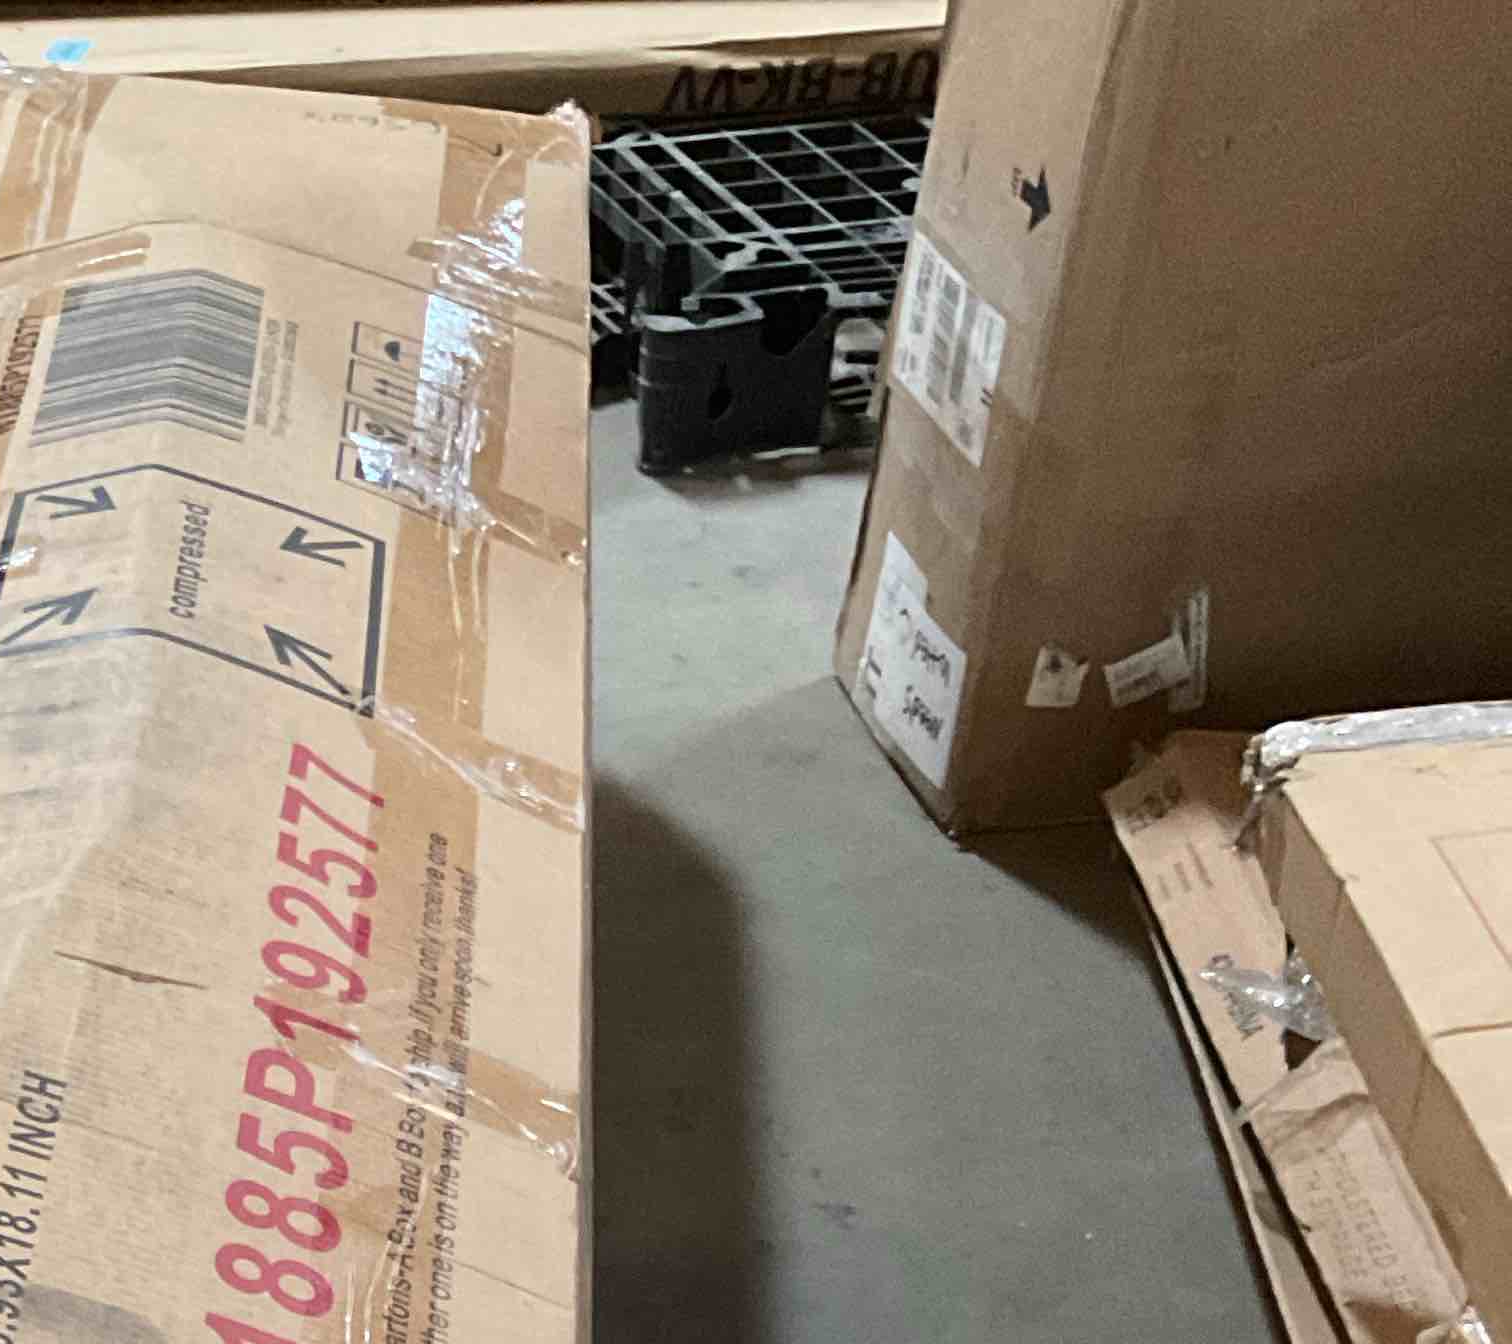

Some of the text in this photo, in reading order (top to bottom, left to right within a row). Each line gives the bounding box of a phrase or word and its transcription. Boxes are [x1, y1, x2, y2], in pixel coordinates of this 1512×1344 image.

[169, 500, 212, 621] compressed
[428, 832, 448, 867] one
[8, 1069, 68, 1161] INCH
[399, 1097, 428, 1139] Bo
[440, 1121, 470, 1163] way
[399, 1156, 422, 1204] and
[433, 1162, 460, 1200] the
[435, 1200, 458, 1231] on
[429, 1233, 455, 1258] is
[431, 1260, 454, 1302] one
